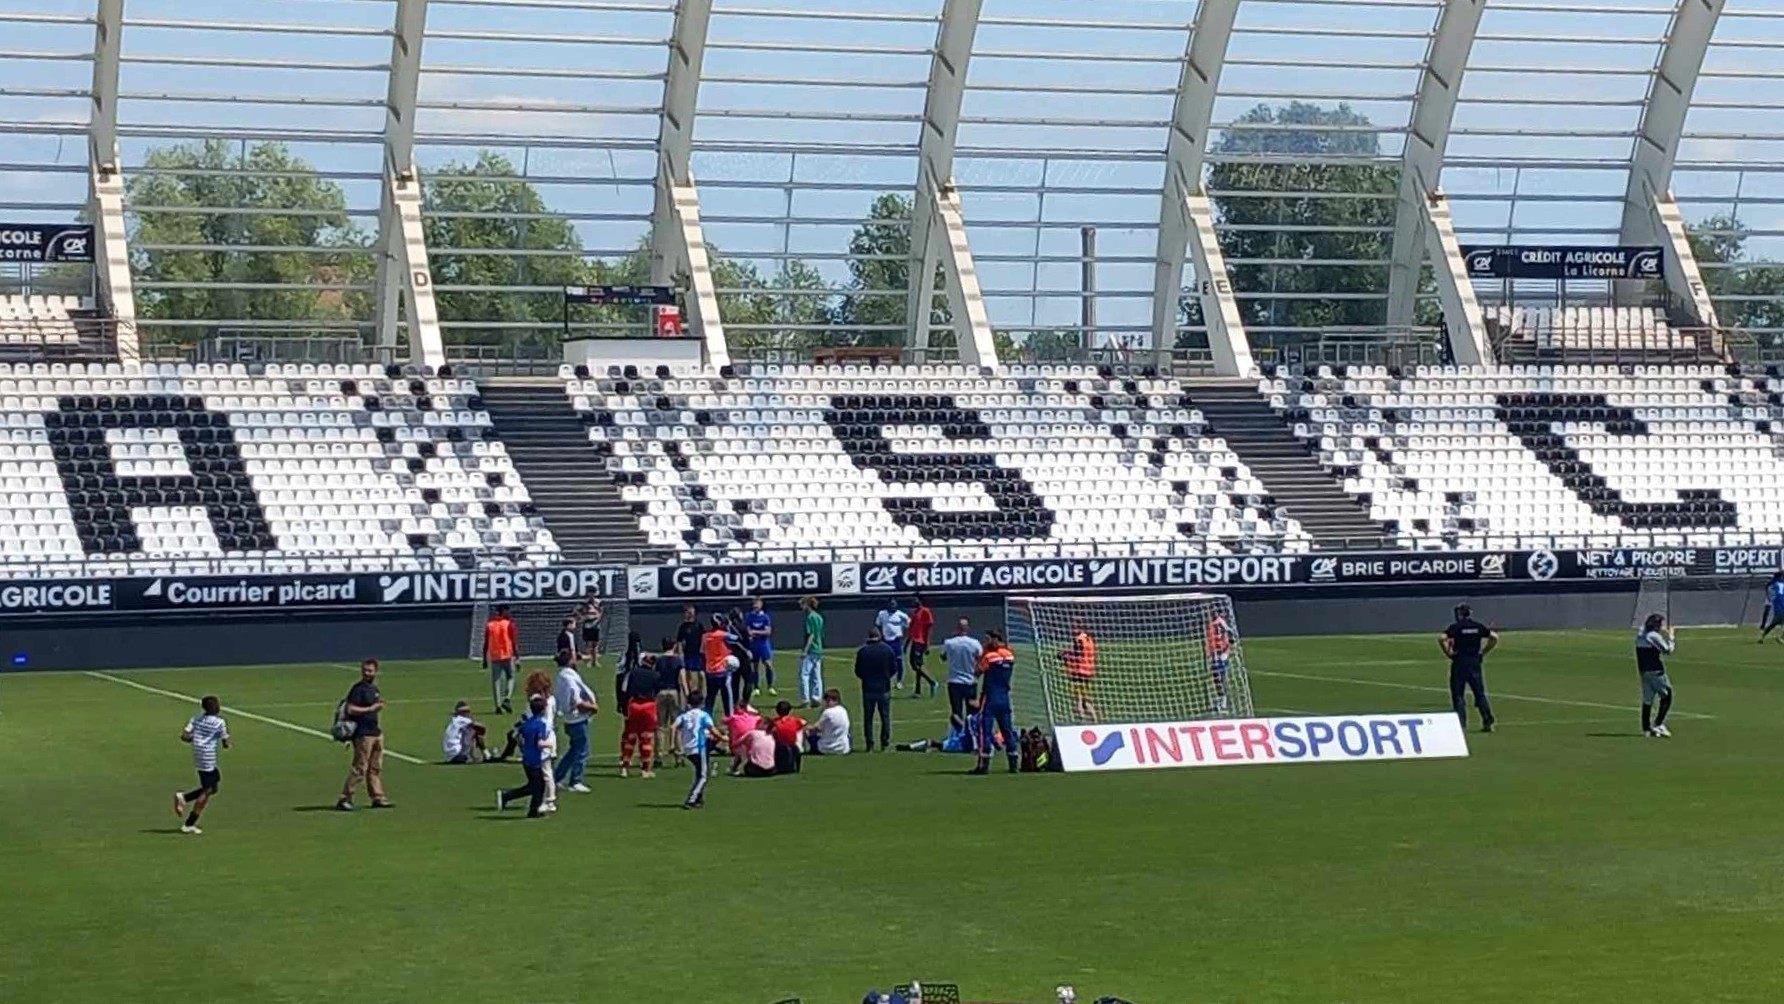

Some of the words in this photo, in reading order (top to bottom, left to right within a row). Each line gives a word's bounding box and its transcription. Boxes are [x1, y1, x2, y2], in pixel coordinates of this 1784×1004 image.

[0, 230, 42, 244] COLE
[1565, 251, 1625, 264] AGRICOLE
[413, 272, 428, 286] D
[1564, 265, 1577, 276] La
[1583, 265, 1625, 276] Licorne
[1216, 280, 1231, 294] E
[1690, 282, 1703, 296] F
[45, 396, 277, 551] A
[823, 393, 1055, 538] S
[1495, 393, 1737, 529] C
[1577, 551, 1611, 565] NET
[1632, 550, 1696, 565] PROPRE
[1715, 550, 1779, 566] EXPERT
[903, 562, 974, 586] CRÉDIT
[980, 563, 1083, 586] AGRICOLE
[1119, 557, 1296, 585] INTERSPORT
[1342, 561, 1385, 576] BRIE
[1390, 559, 1475, 575] PICARDIE
[414, 570, 615, 600] INTERSPORT
[672, 567, 818, 595] Groupama
[0, 585, 111, 607] GRICOLE
[168, 581, 271, 603] Courrier
[279, 579, 356, 604] picard
[1129, 718, 1424, 764] INTERSPORT
